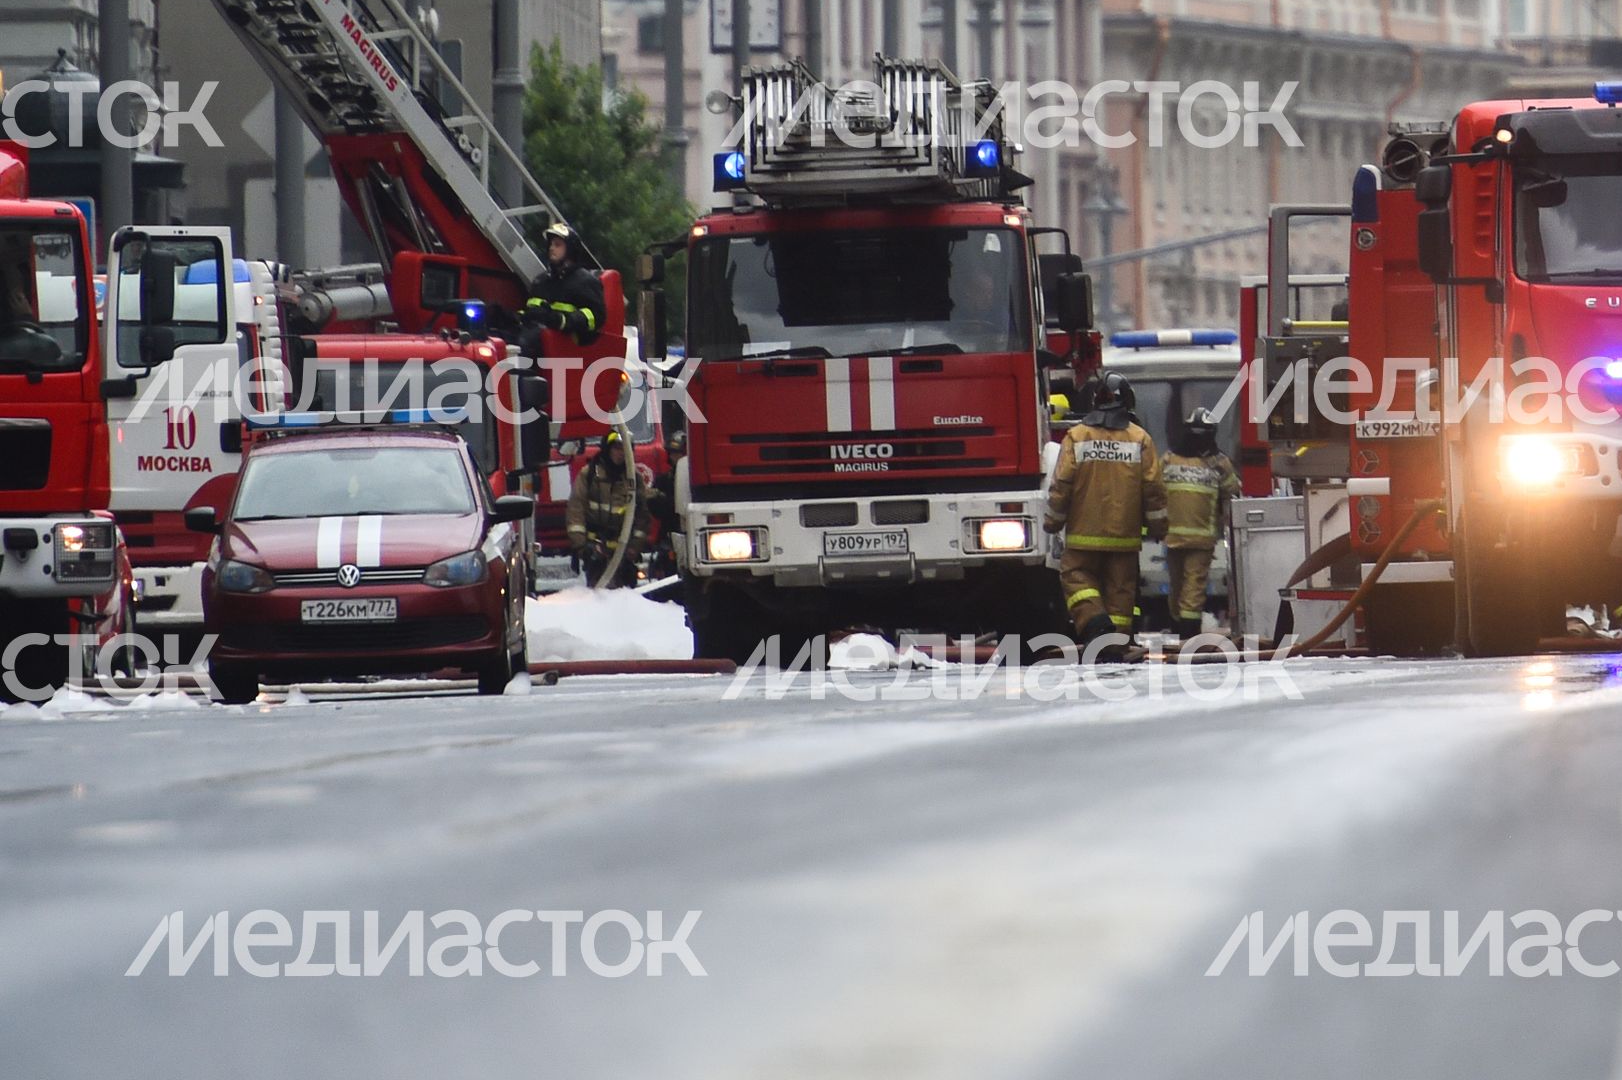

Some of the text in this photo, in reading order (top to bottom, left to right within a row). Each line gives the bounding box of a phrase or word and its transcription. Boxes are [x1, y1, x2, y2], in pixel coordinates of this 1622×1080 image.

[340, 13, 398, 92] MAGIRUS
[933, 415, 983, 425] EuroFire
[162, 405, 196, 450] 10
[830, 443, 894, 459] IVECO
[1093, 440, 1120, 451] МЧС
[1083, 451, 1132, 461] РОССИИ
[137, 455, 212, 473] МОСКВА
[834, 461, 889, 473] MAGIRUS
[884, 534, 903, 546] 197
[307, 600, 392, 618] Т226КМ 777
